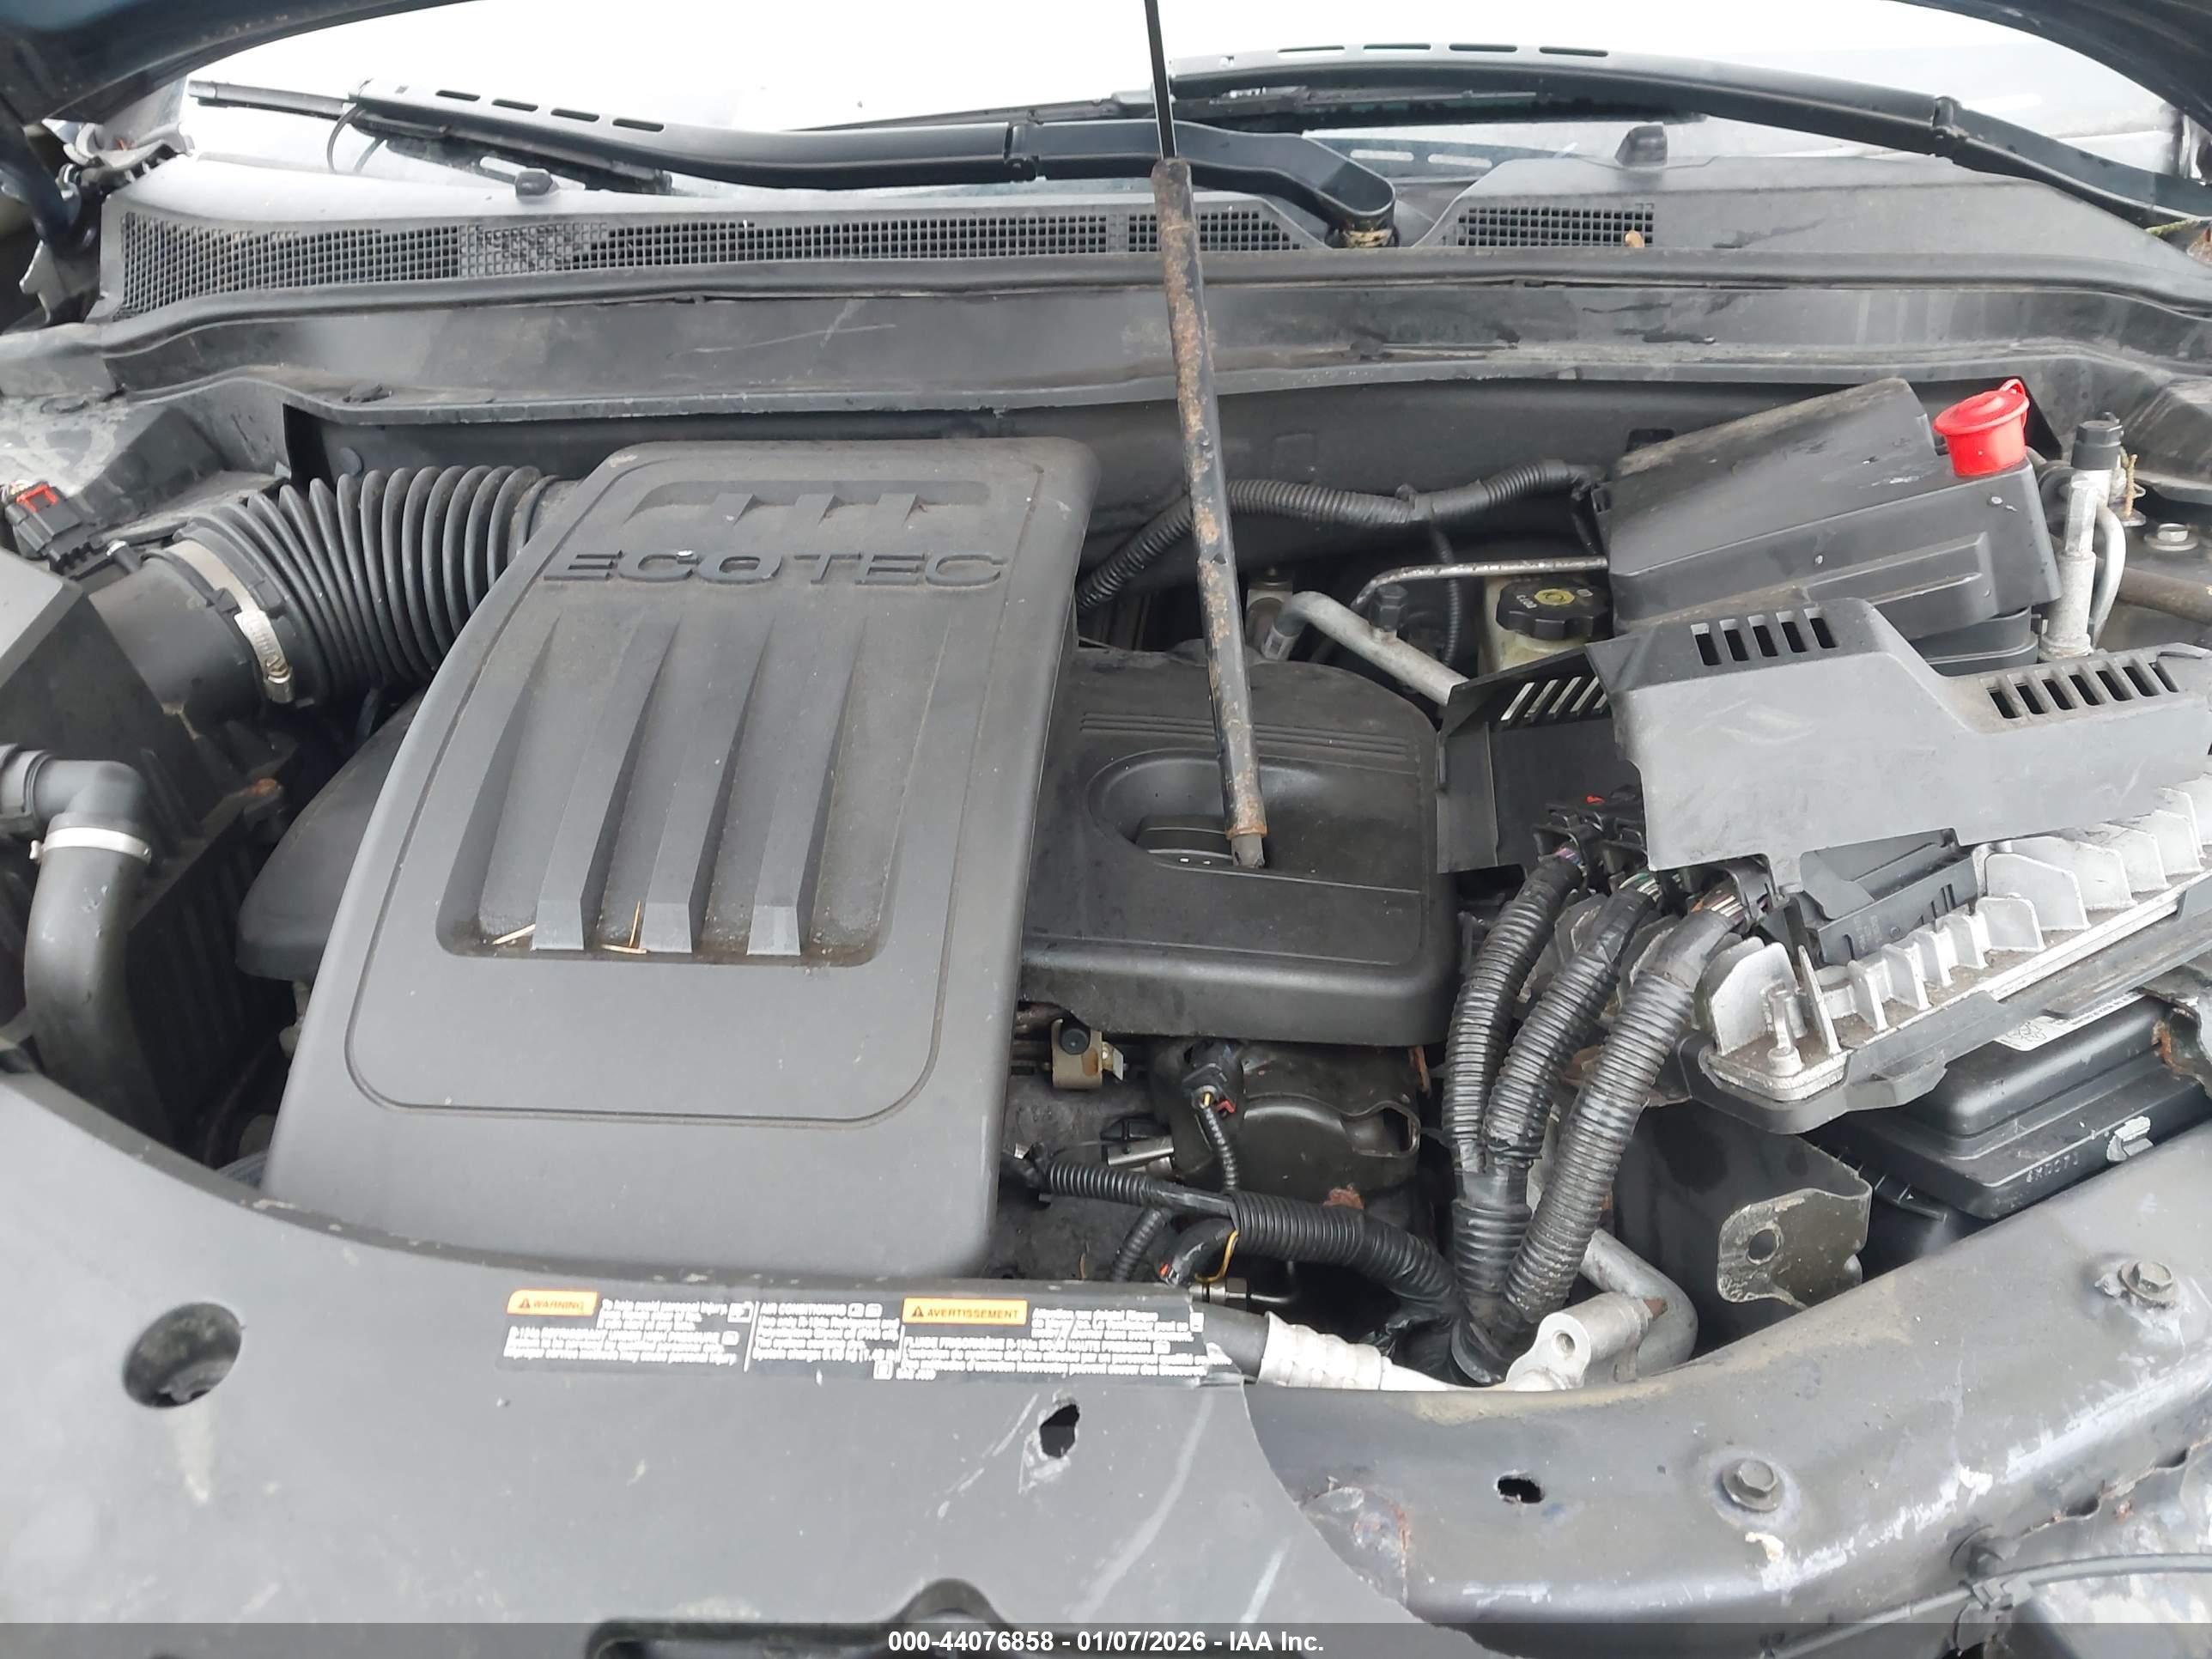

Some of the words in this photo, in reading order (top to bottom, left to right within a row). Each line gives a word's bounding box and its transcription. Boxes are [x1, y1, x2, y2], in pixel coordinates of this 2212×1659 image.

[544, 548, 1009, 587] ECOTEC
[533, 1299, 585, 1310] WARNING
[927, 1307, 1019, 1320] AVERTISSEMENT
